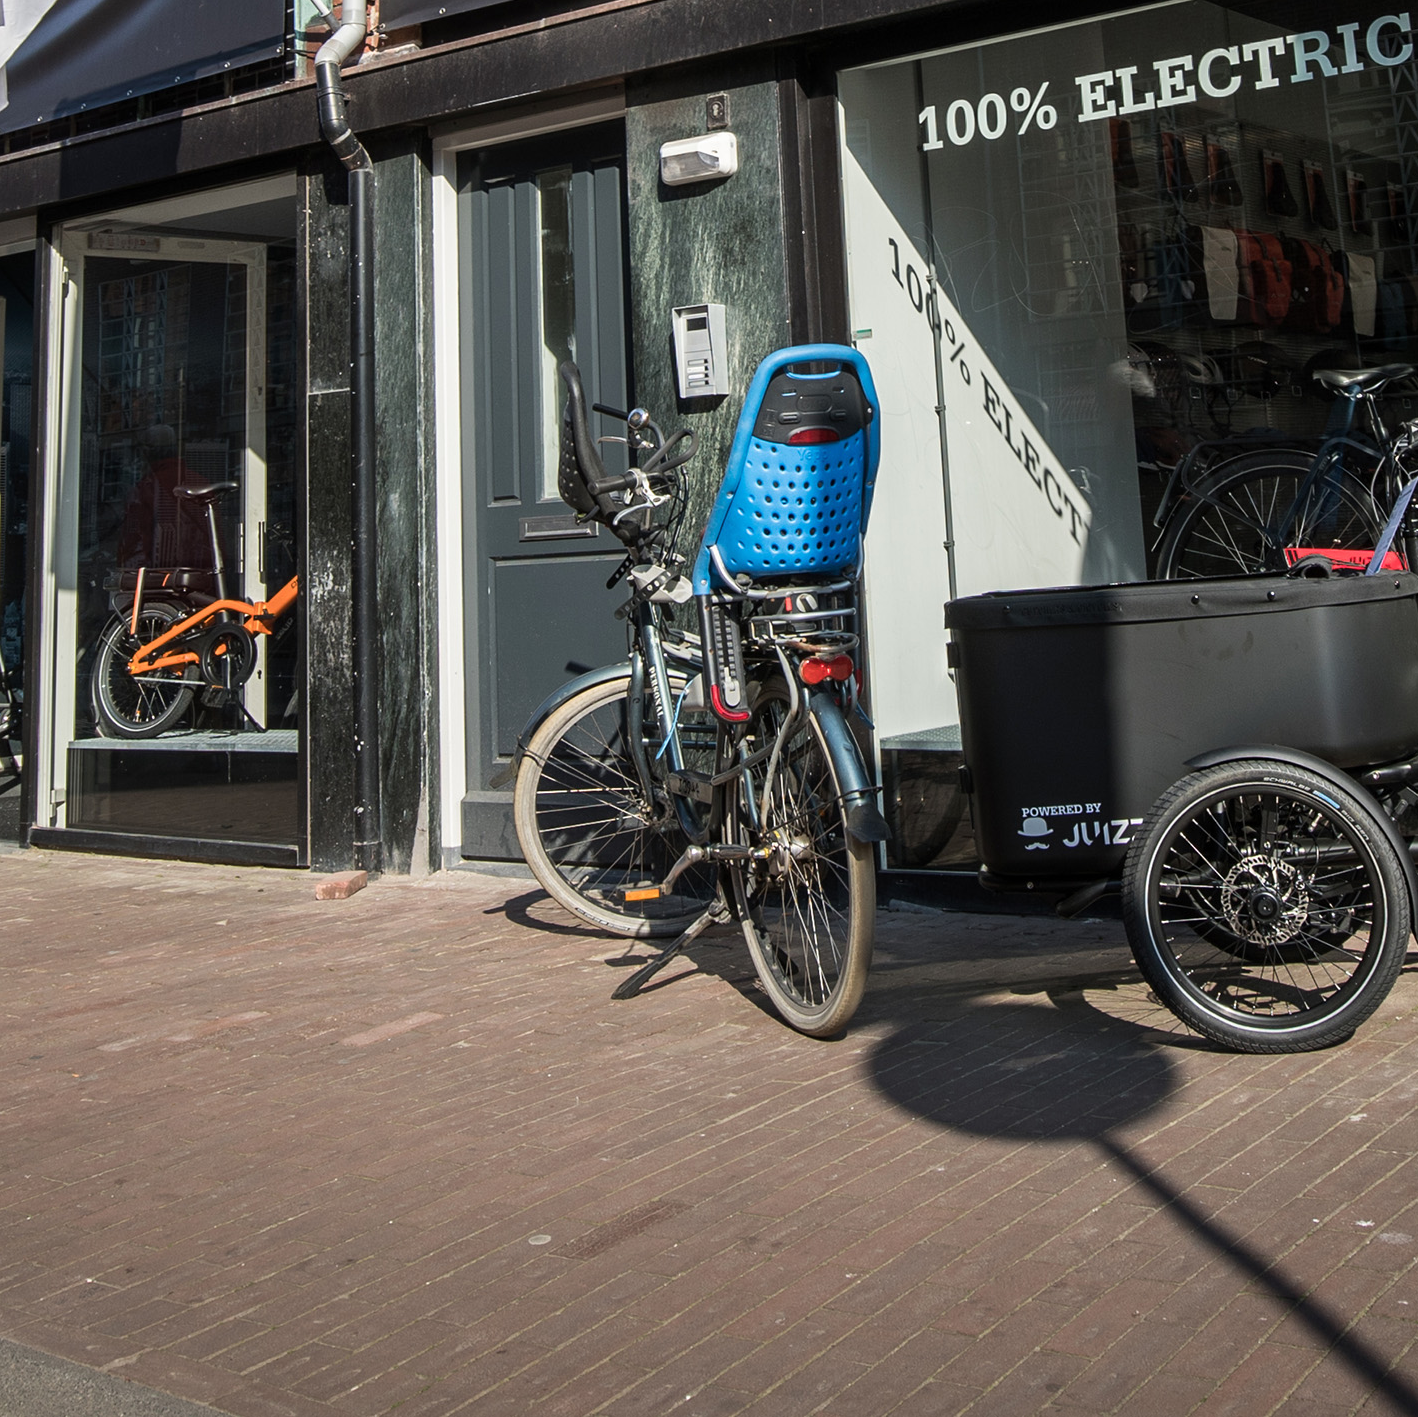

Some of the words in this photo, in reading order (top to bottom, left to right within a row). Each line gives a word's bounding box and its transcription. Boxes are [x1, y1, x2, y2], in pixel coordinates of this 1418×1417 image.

[917, 81, 1058, 152] 100%
[1073, 12, 1415, 124] ELECTRIC
[648, 665, 664, 720] PERSONAL
[1021, 803, 1083, 818] POWERED
[1085, 802, 1102, 814] BY
